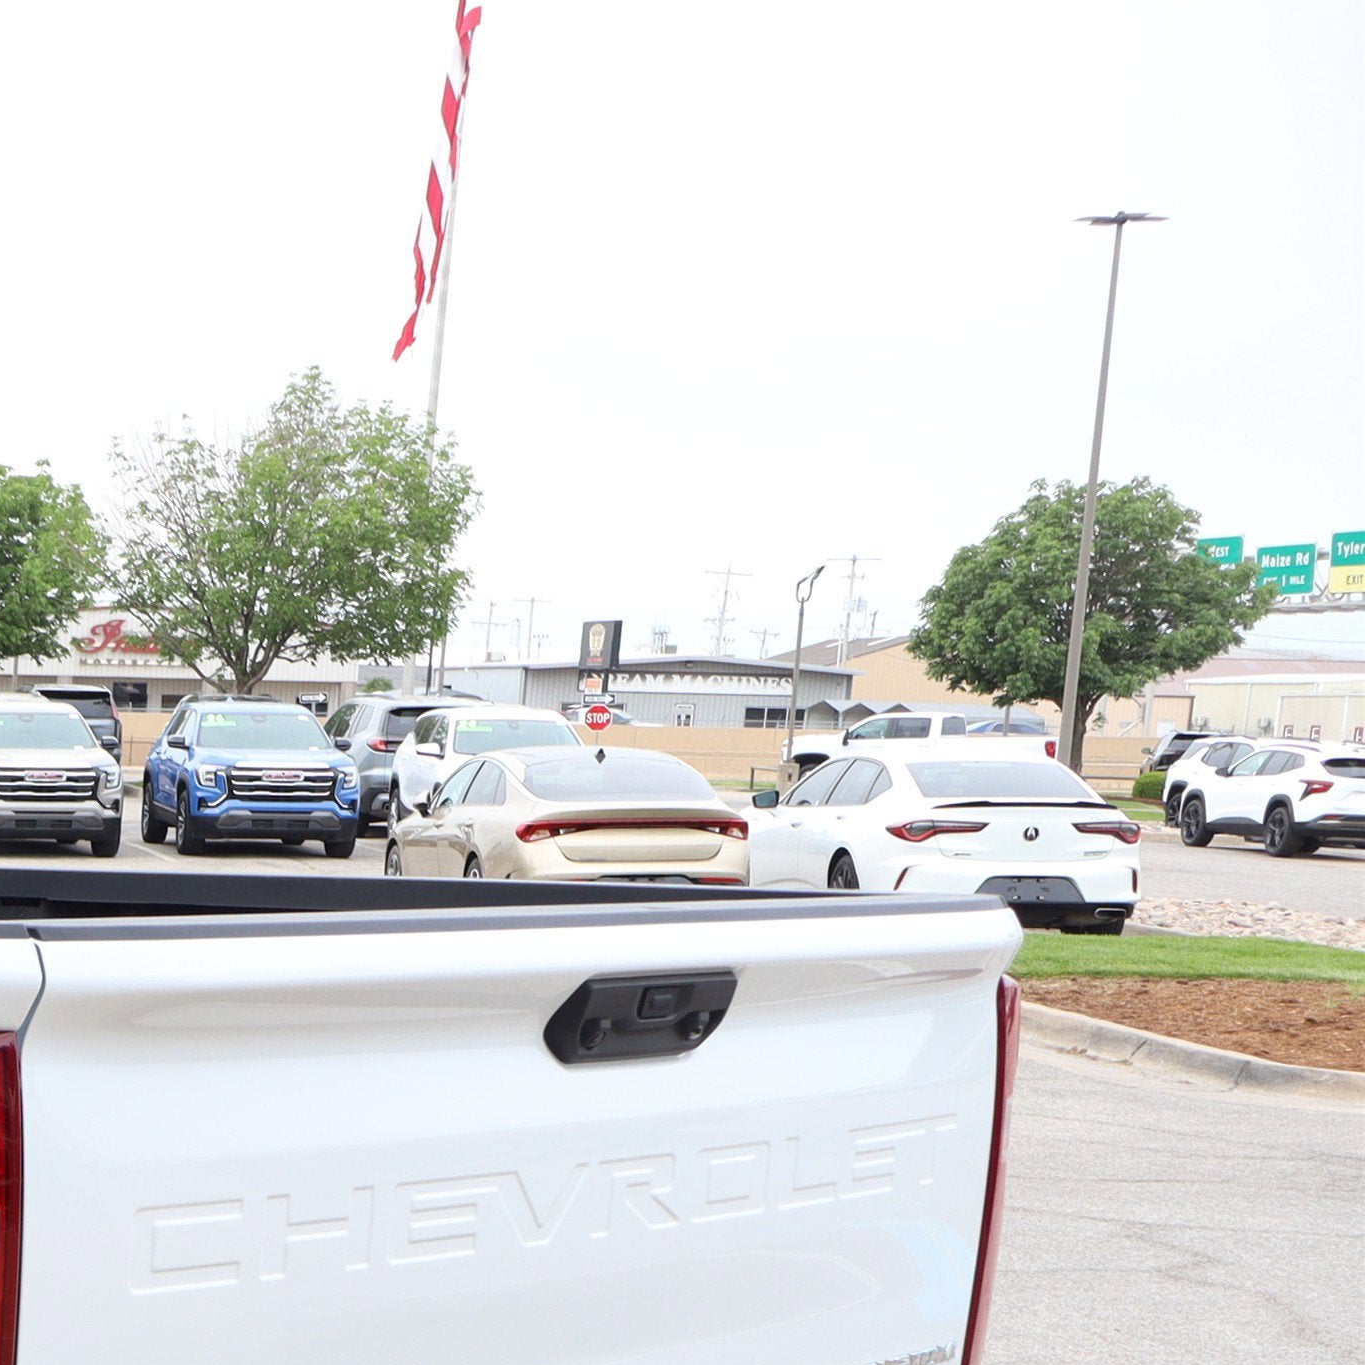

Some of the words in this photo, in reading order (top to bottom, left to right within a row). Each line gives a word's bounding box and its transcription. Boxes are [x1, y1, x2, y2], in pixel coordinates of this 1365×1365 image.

[1337, 541, 1365, 558] Tyler
[1261, 554, 1291, 568] Maize
[1295, 552, 1310, 566] Rd
[1289, 574, 1306, 585] MILE
[1346, 574, 1364, 585] EXIT
[588, 671, 666, 687] REAM
[672, 673, 794, 691] MACHINES
[586, 712, 610, 724] STOP
[127, 1112, 959, 1296] CHEVROLET
